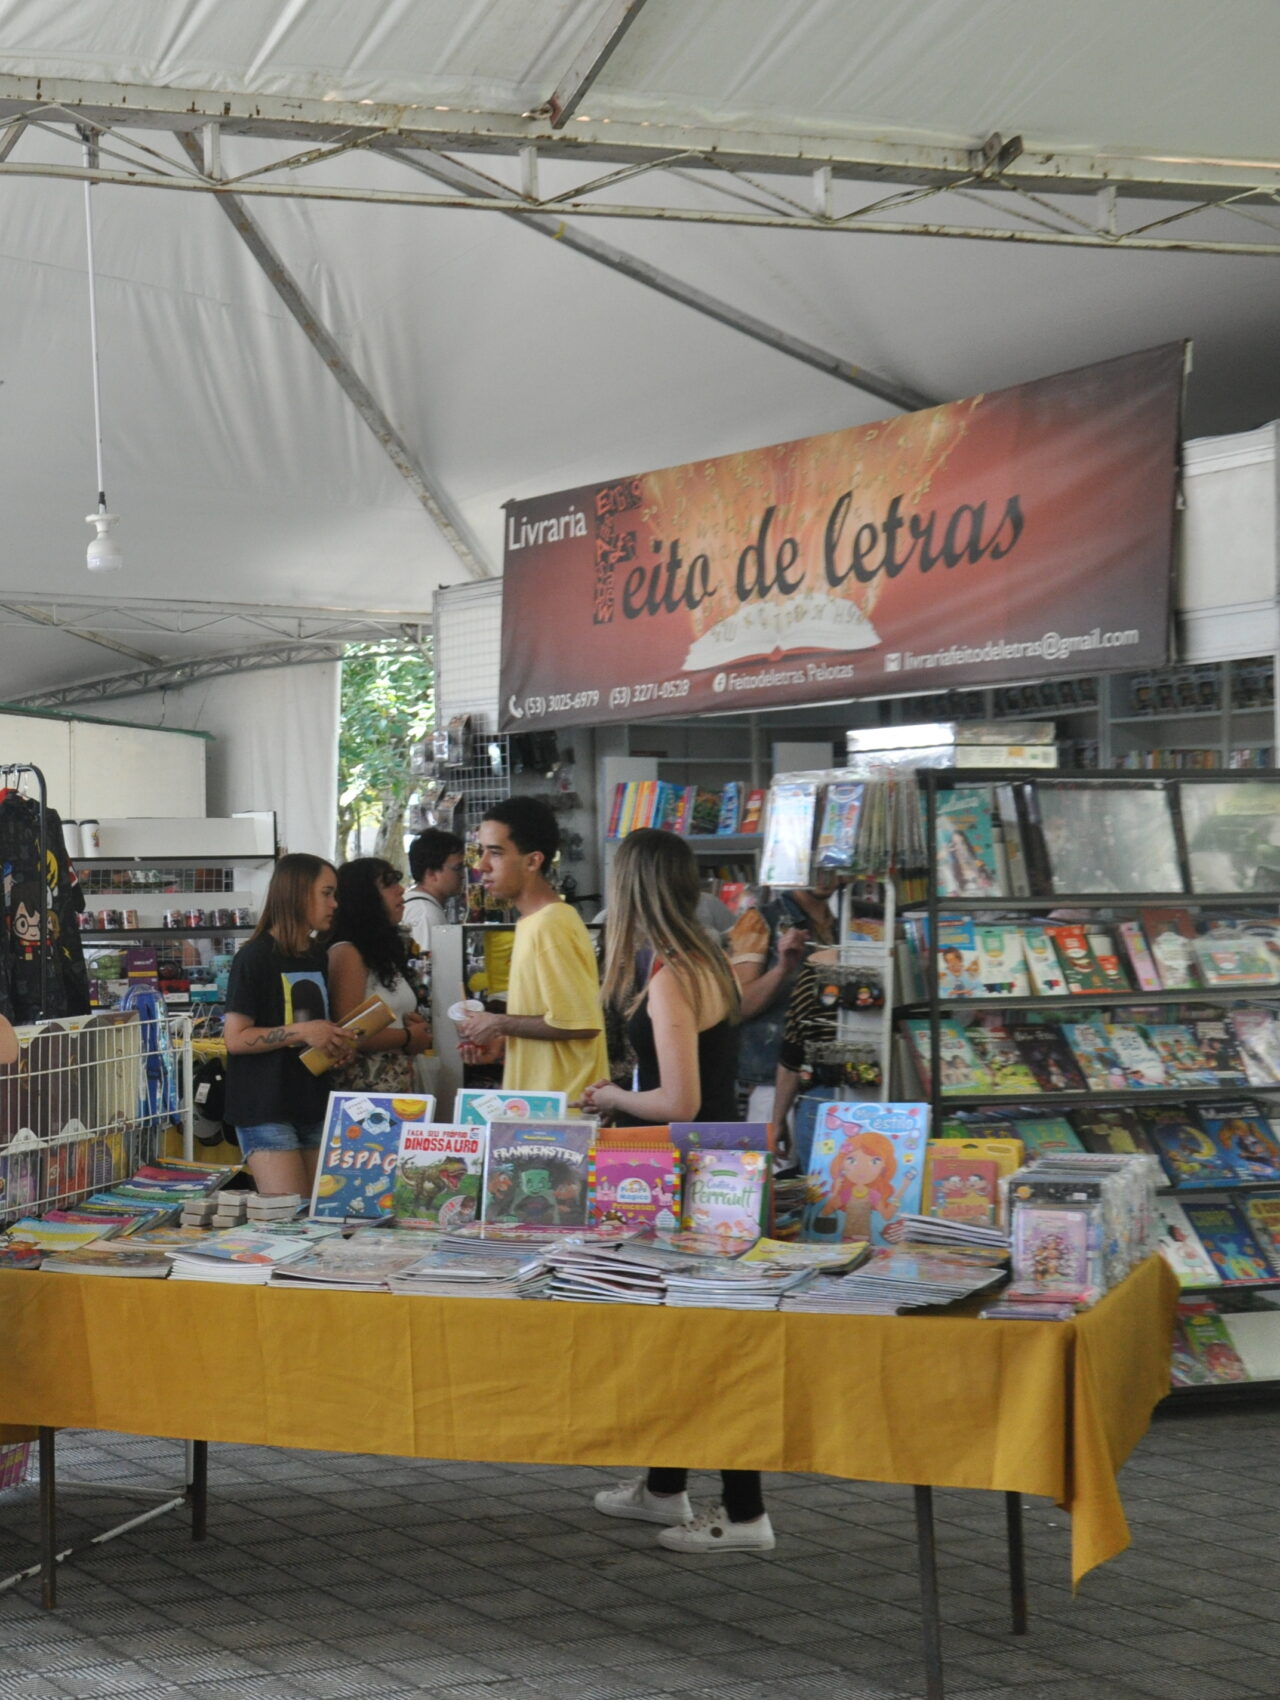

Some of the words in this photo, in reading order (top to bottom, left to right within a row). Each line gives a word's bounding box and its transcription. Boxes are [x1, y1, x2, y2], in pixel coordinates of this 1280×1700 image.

[509, 505, 587, 550] Livraria
[736, 504, 804, 602] de
[824, 489, 1025, 588] letras
[807, 663, 854, 682] Pelotas
[524, 695, 547, 718] (53)
[548, 689, 600, 712] 3025-6979
[609, 686, 631, 709] (53)
[404, 1138, 479, 1154] DINOSSAURO
[492, 1145, 585, 1164] FRANKENSTEIN
[327, 1149, 398, 1175] ESPAÇ
